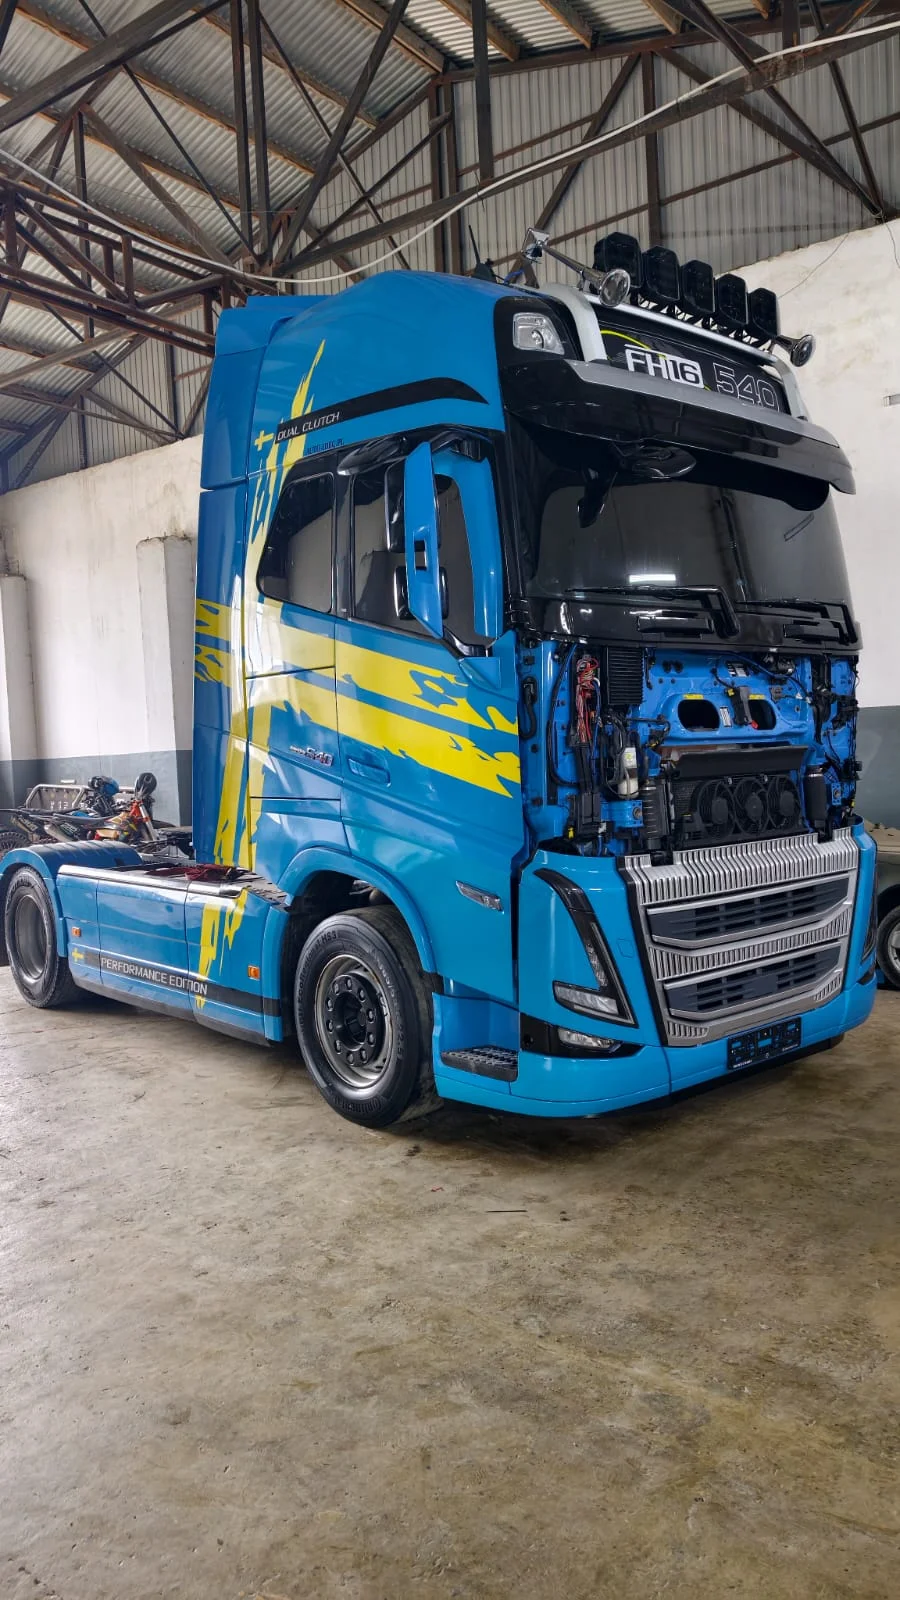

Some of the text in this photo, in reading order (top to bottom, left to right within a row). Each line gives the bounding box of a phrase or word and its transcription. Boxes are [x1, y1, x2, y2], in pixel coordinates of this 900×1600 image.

[625, 348, 780, 413] FH16 540
[277, 411, 340, 441] DUAL CLUTCH
[100, 957, 208, 995] PERFORMANCE EDITION
